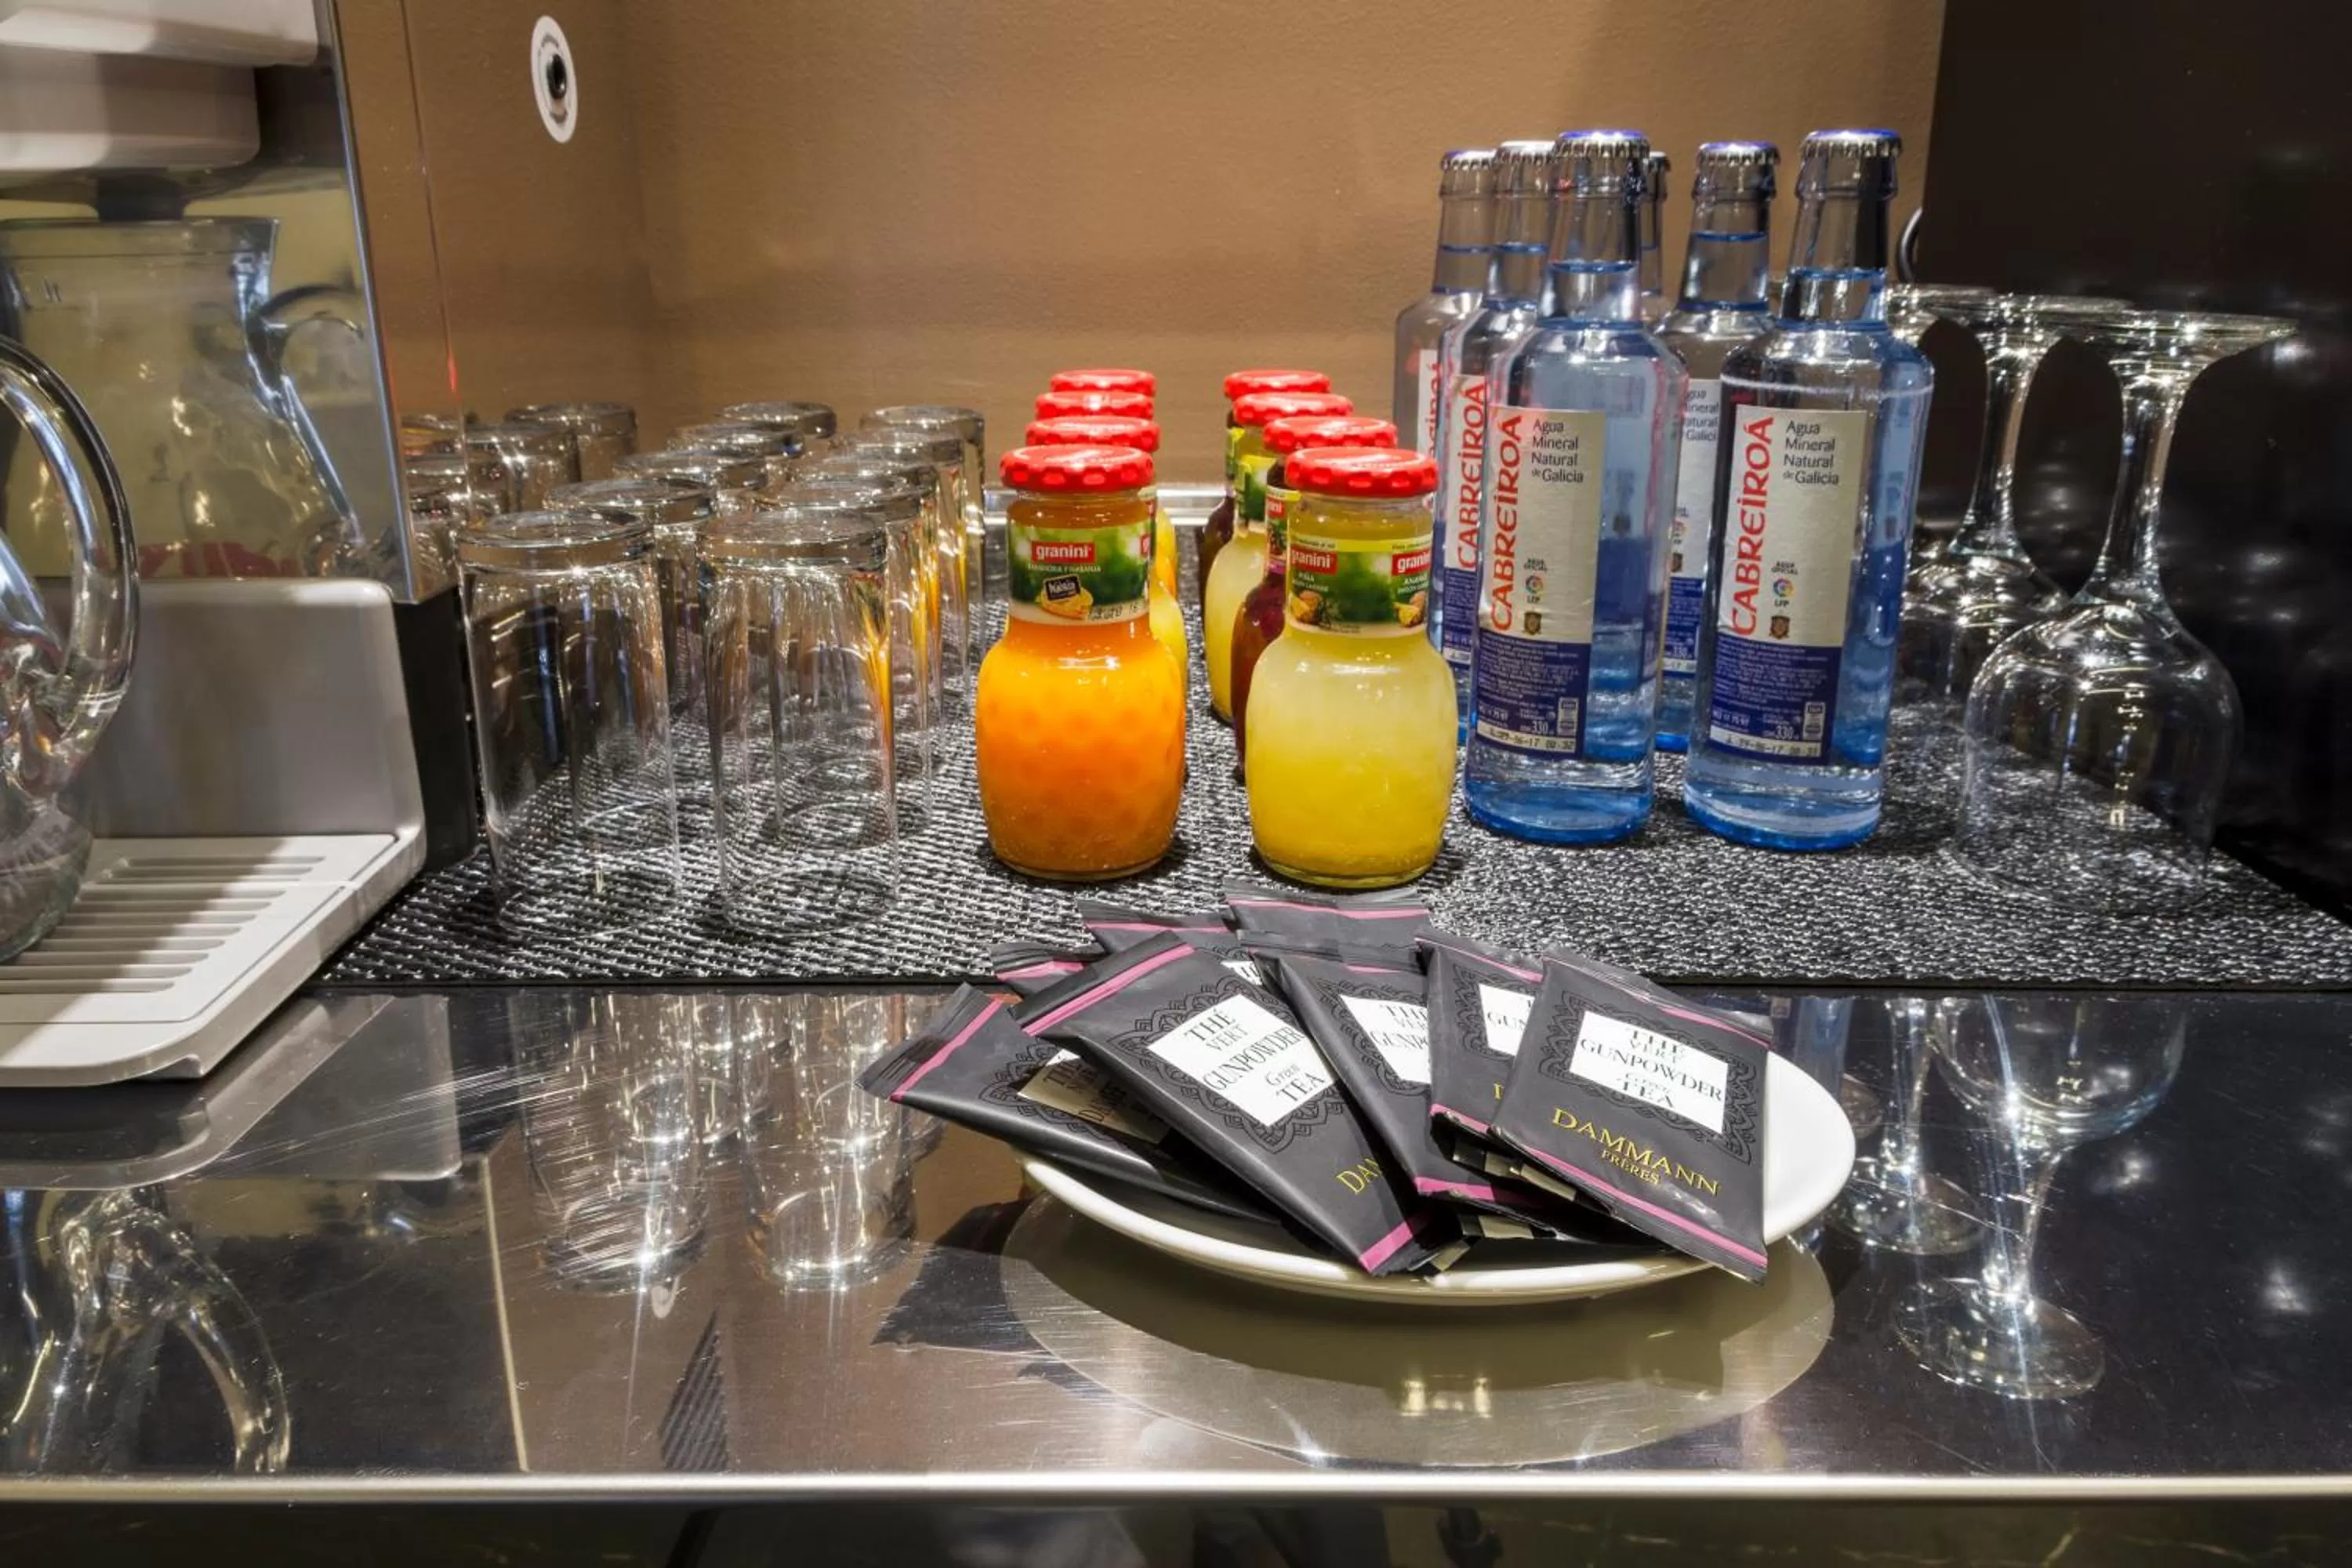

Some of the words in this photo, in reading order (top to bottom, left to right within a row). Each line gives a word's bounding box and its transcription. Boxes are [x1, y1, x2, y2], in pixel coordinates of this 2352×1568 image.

[1533, 419, 1564, 434] Agua
[1786, 420, 1820, 436] Agua
[1532, 436, 1579, 450] Mineral
[1785, 437, 1835, 452] Mineral
[1531, 452, 1577, 466] Natural
[1784, 454, 1835, 469] Natural
[1542, 468, 1584, 484] Galicia
[1795, 470, 1839, 485] Galicia
[1491, 415, 1523, 631] CABREIROÁ
[1730, 416, 1774, 637] CABREIROÁ
[1036, 544, 1089, 559] granini
[1206, 1024, 1249, 1051] VERT
[1203, 1026, 1305, 1091] GUNPOWDER
[1581, 1038, 1722, 1102] GUNPOWDER
[1276, 1072, 1325, 1102] TEA
[1617, 1077, 1673, 1108] TEA
[1552, 1107, 1720, 1196] DAMMANN
